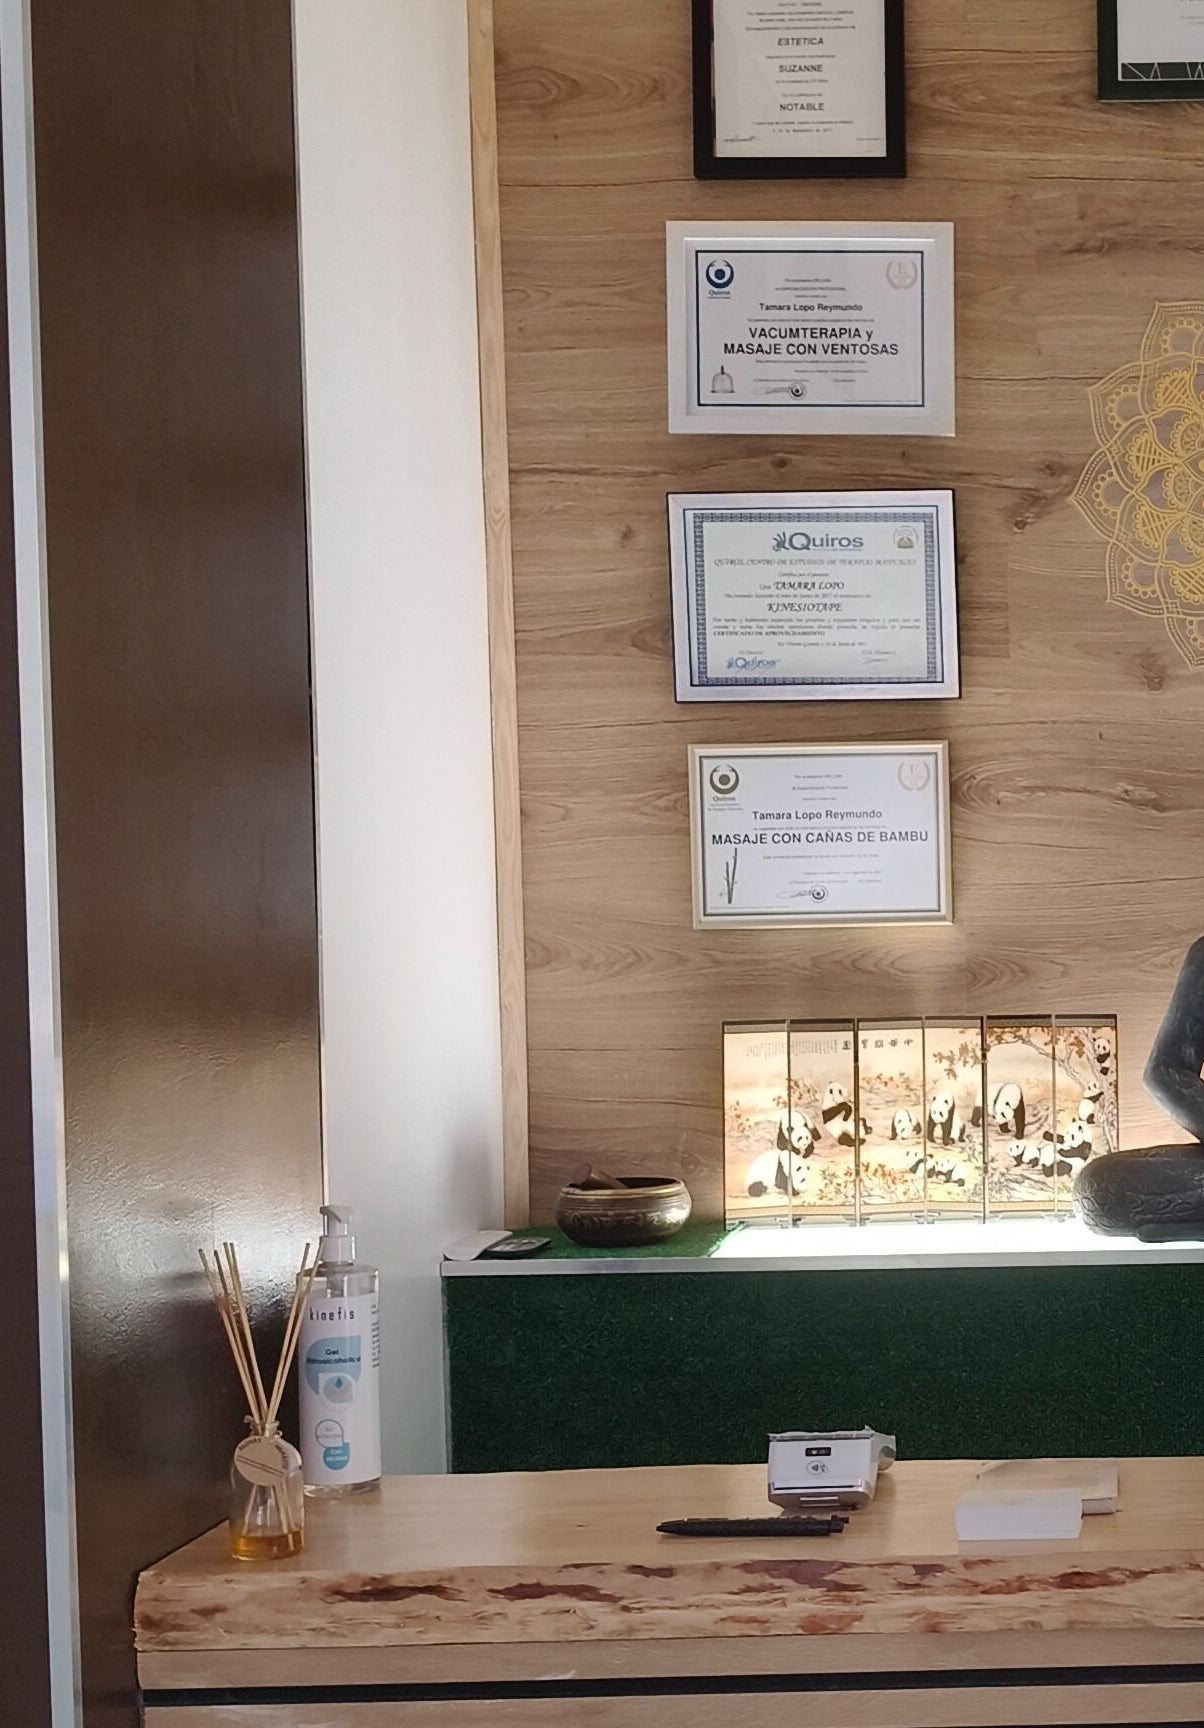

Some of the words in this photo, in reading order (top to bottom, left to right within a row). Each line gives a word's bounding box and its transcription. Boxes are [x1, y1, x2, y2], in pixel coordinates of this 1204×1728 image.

[779, 64, 824, 73] SUZANNE
[779, 103, 825, 112] NOTABLE
[759, 302, 791, 312] Tamara
[793, 302, 815, 314] Lopo
[817, 302, 863, 314] Reymundo
[748, 327, 862, 340] VACUMTERAPIA
[865, 328, 874, 342] y
[723, 343, 783, 356] MASAJE
[785, 343, 817, 356] CON
[821, 343, 900, 356] VENTOSAS
[788, 531, 864, 551] Quiros
[773, 581, 816, 591] TAMARA
[818, 581, 845, 590] LOPO
[766, 602, 843, 613] KINESIOTAPE
[752, 810, 792, 820] Tamara
[795, 810, 822, 822] Lopo
[825, 809, 882, 821] Reymundo
[711, 833, 768, 845] MASAJE
[771, 832, 802, 844] CON
[805, 829, 853, 843] CAÑAS
[856, 831, 876, 843] DE
[309, 1306, 355, 1322] kinefis
[325, 1348, 339, 1356] Gel
